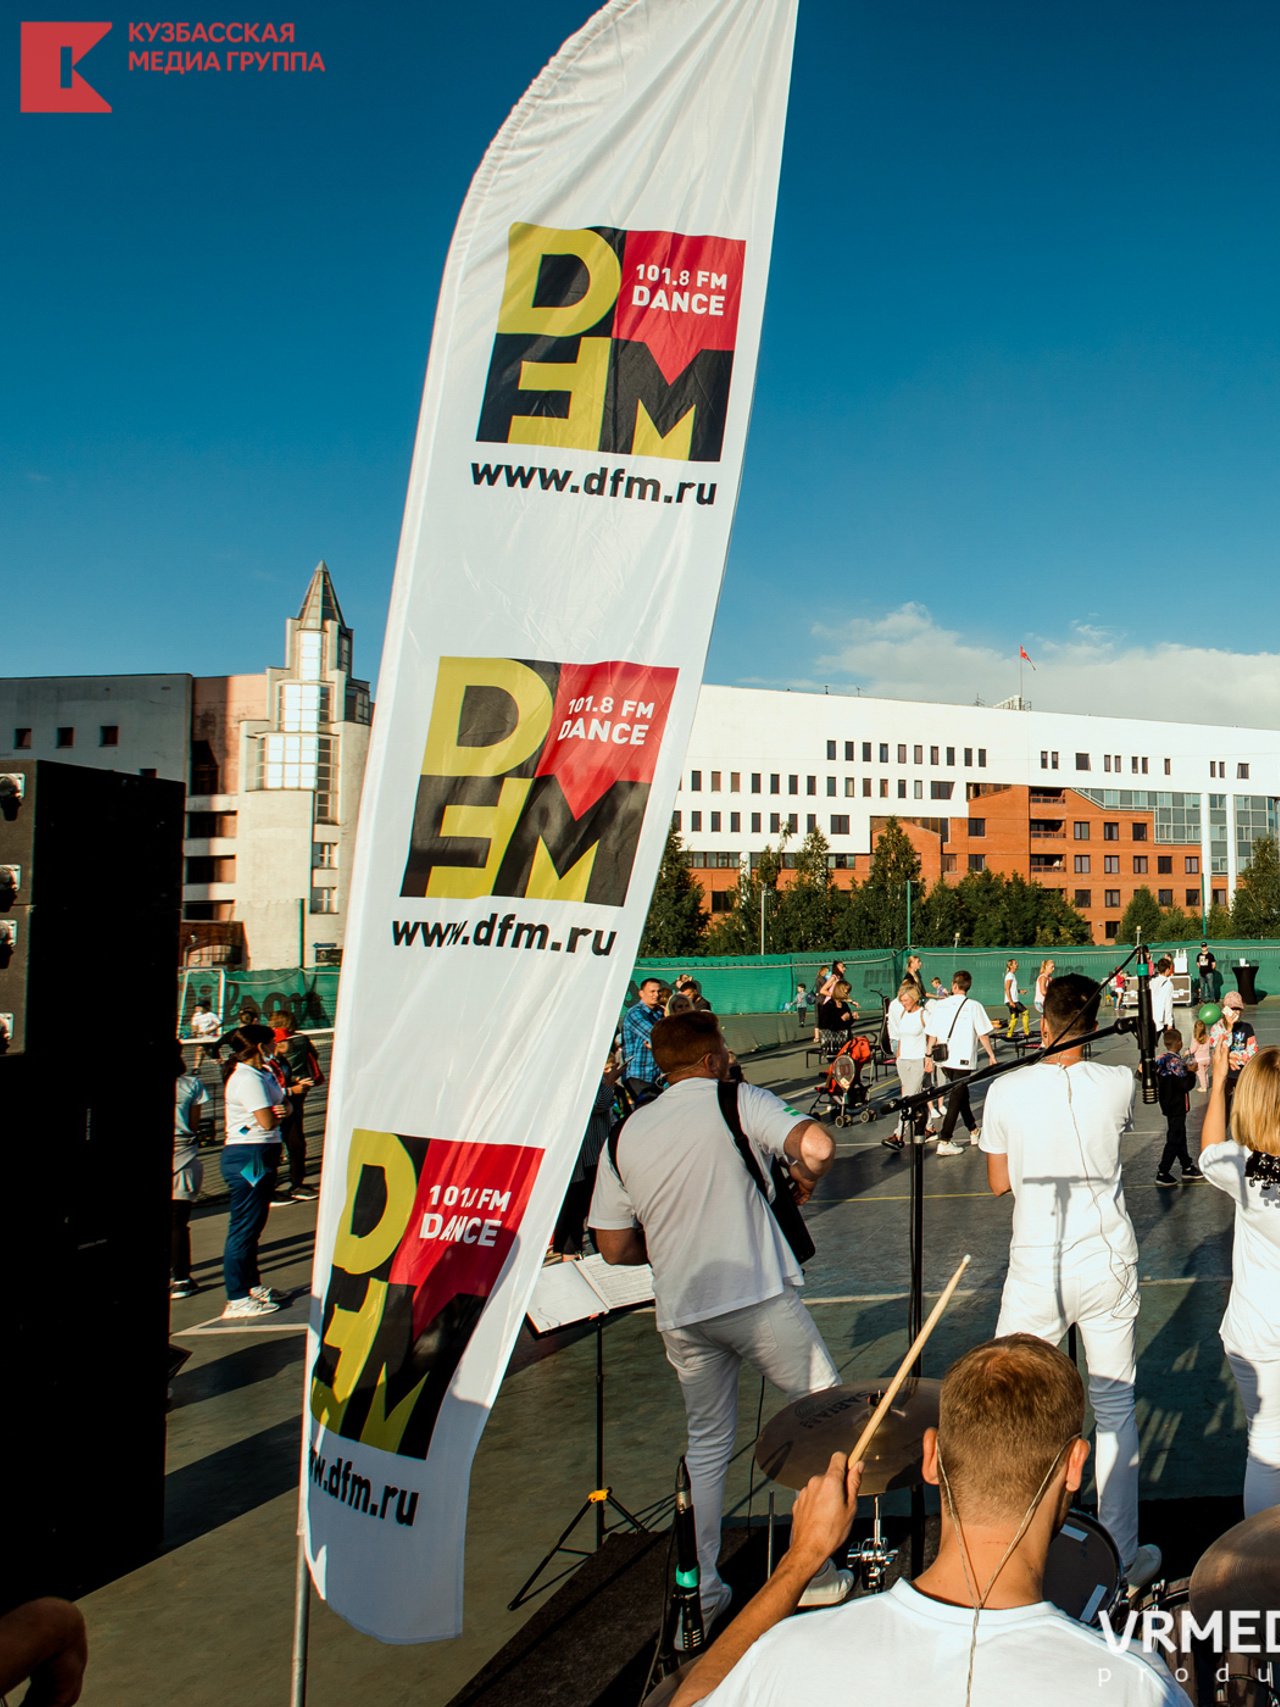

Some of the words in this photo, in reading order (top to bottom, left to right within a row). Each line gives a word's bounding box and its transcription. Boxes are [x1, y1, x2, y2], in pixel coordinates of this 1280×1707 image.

[636, 264, 690, 286] 101.8
[697, 270, 727, 290] FM
[632, 285, 726, 316] DANCE
[471, 462, 718, 505] www.dfm.ru
[568, 695, 614, 715] 101.8
[621, 700, 655, 719] FM
[557, 718, 649, 746] DANCE
[392, 913, 617, 956] www.dfm.ru
[477, 1188, 512, 1212] FM
[419, 1213, 503, 1247] DANCE
